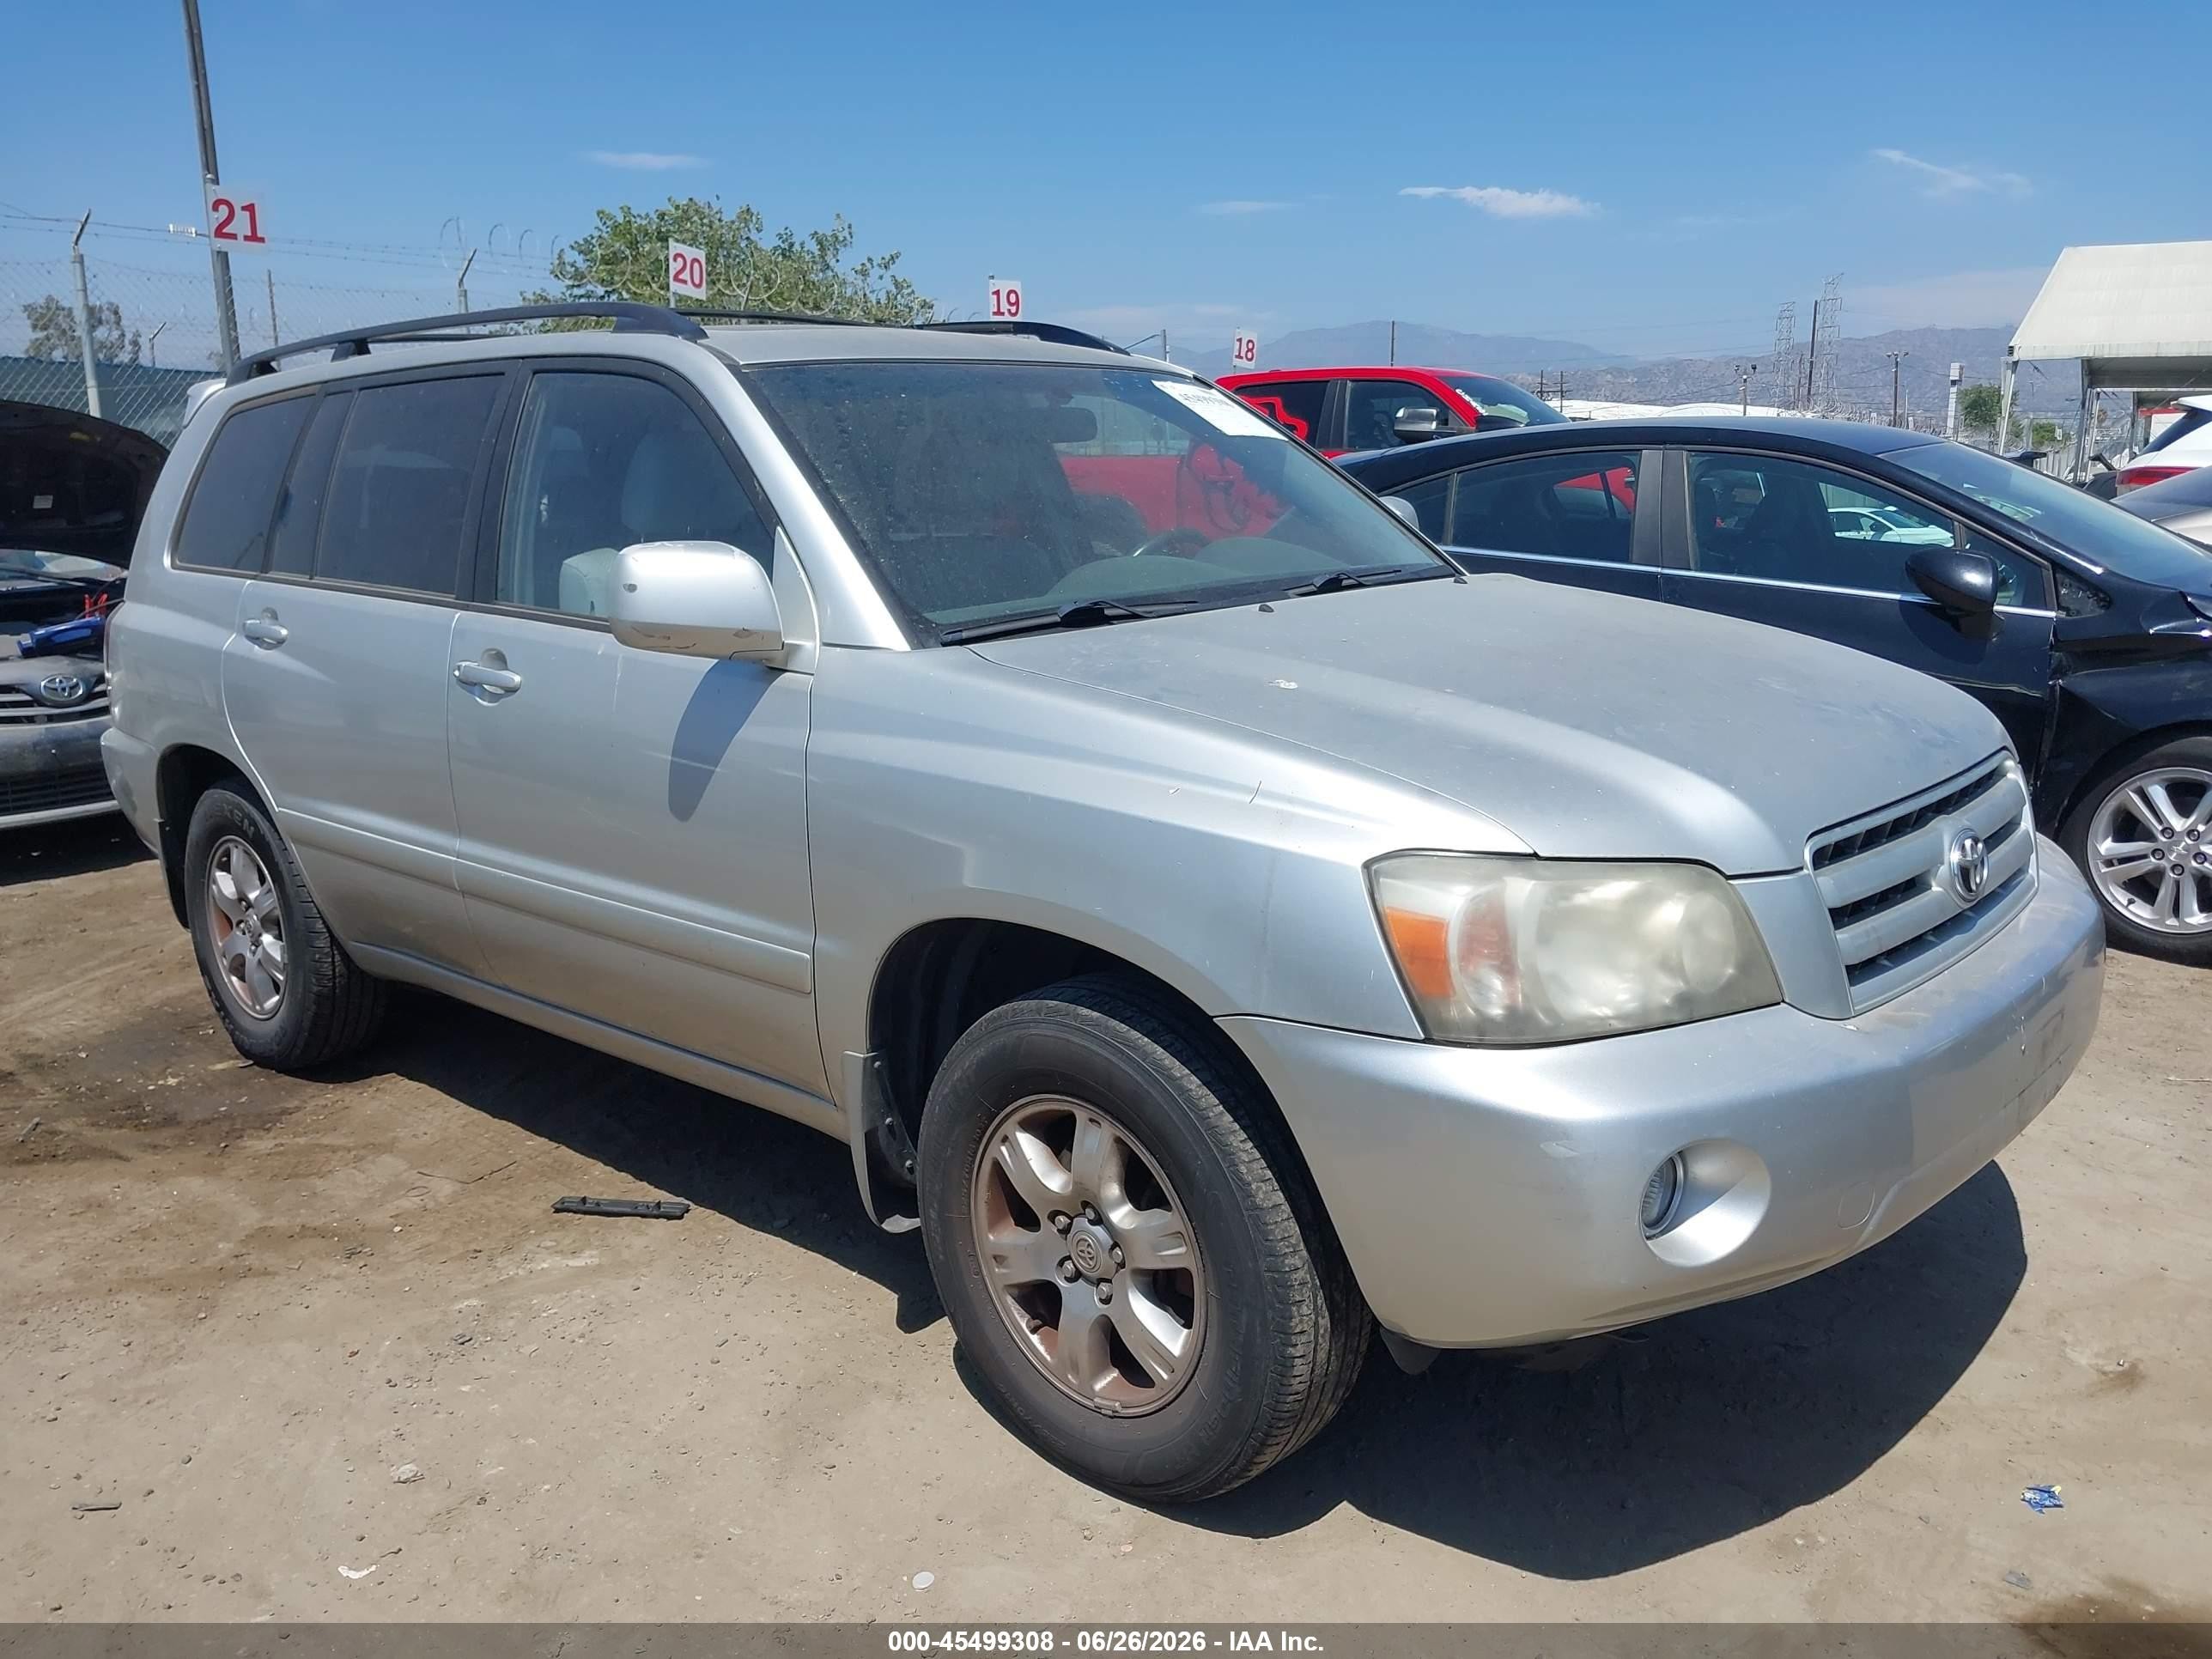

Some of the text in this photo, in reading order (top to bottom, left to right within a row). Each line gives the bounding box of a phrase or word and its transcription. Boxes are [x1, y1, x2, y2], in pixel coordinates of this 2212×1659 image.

[211, 198, 265, 243] 21
[672, 252, 704, 289] 20
[991, 289, 1020, 318] 19
[1234, 337, 1255, 362] 18
